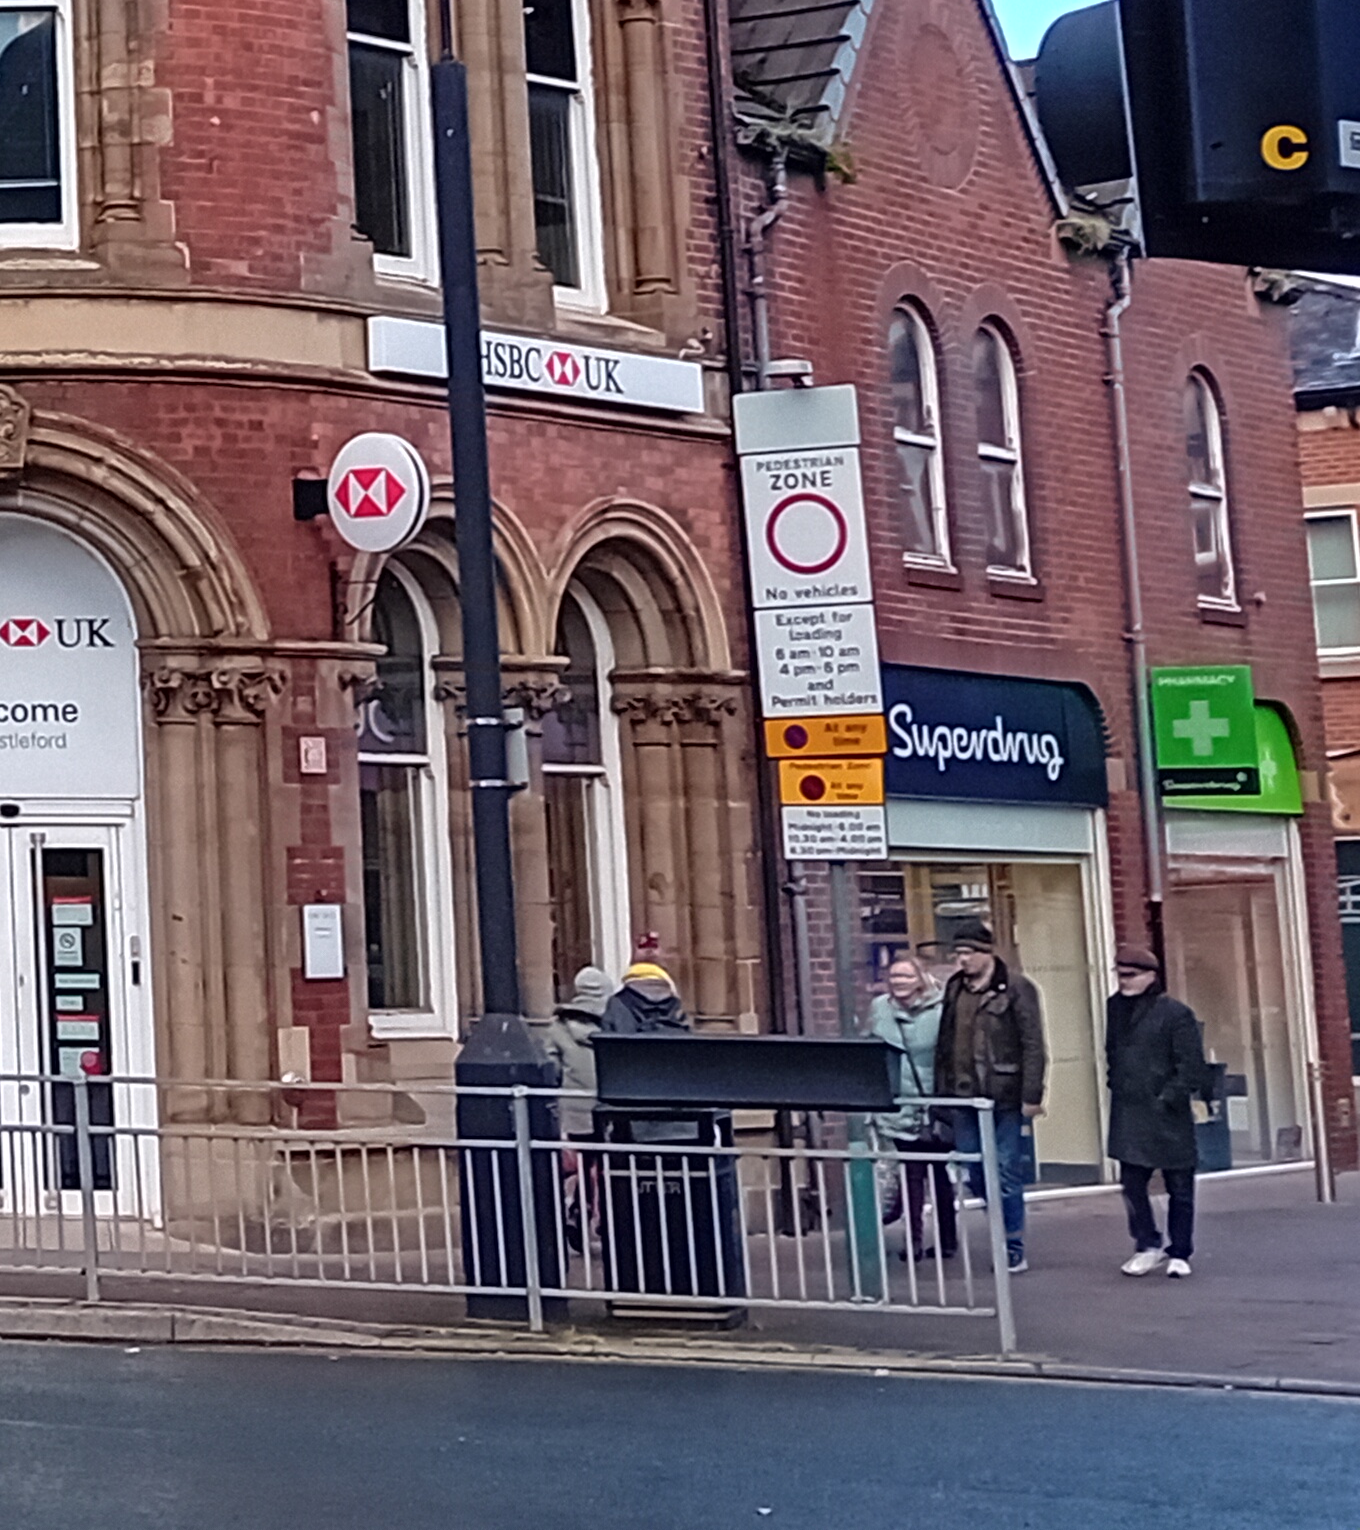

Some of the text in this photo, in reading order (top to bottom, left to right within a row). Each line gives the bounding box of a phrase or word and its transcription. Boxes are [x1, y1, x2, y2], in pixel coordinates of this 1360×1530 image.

[1262, 125, 1309, 170] C
[582, 355, 624, 394] UK
[756, 456, 844, 472] PEDESTRIAN
[769, 470, 832, 490] ZONE
[765, 584, 858, 600] No vehicles
[775, 611, 852, 626] Except for
[54, 618, 115, 648] UK
[839, 647, 860, 657] am
[779, 663, 789, 675] 4
[837, 663, 860, 676] pm
[807, 679, 833, 691] and
[772, 692, 878, 707] Permit holders
[889, 703, 1064, 781] Superdrug
